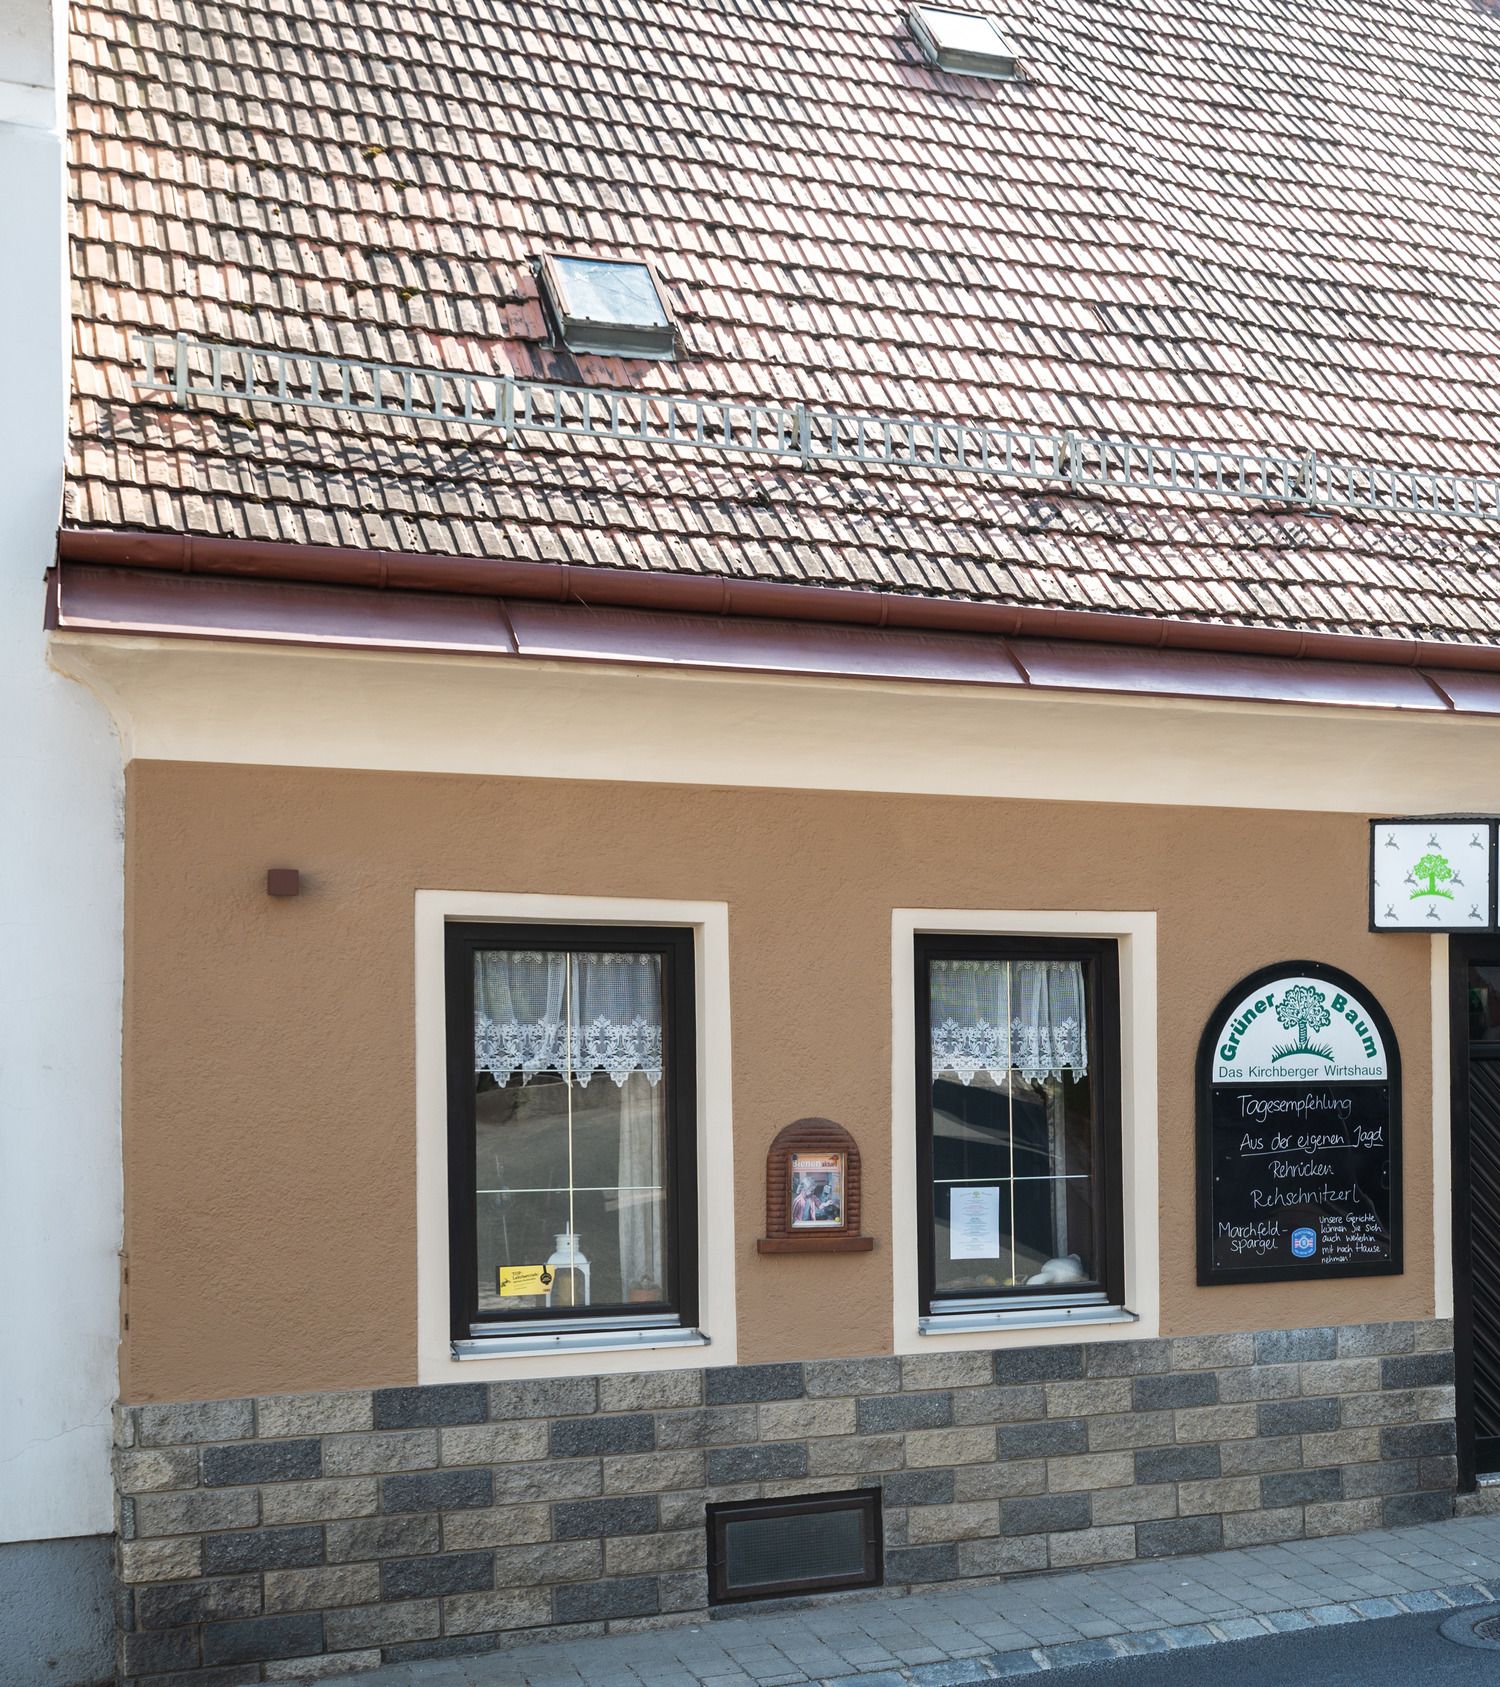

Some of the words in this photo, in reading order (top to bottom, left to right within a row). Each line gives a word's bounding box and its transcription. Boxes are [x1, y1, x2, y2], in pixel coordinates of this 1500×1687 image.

[1219, 992, 1275, 1062] Grüner
[1331, 993, 1378, 1059] Baum
[1219, 1066, 1243, 1078] Das
[1248, 1065, 1319, 1080] Kirchberger
[1324, 1065, 1382, 1077] Wirtshaus
[1236, 1093, 1352, 1123] Tagesempfehlung
[1239, 1133, 1265, 1151] Aus
[1271, 1131, 1293, 1151] der
[1297, 1132, 1345, 1154] eigenen
[1353, 1124, 1384, 1148] Jagd
[1250, 1183, 1360, 1208] Rehschnitzerl
[1230, 1238, 1278, 1255] spargel
[1321, 1233, 1341, 1243] auch
[1356, 1243, 1381, 1253] Hause
